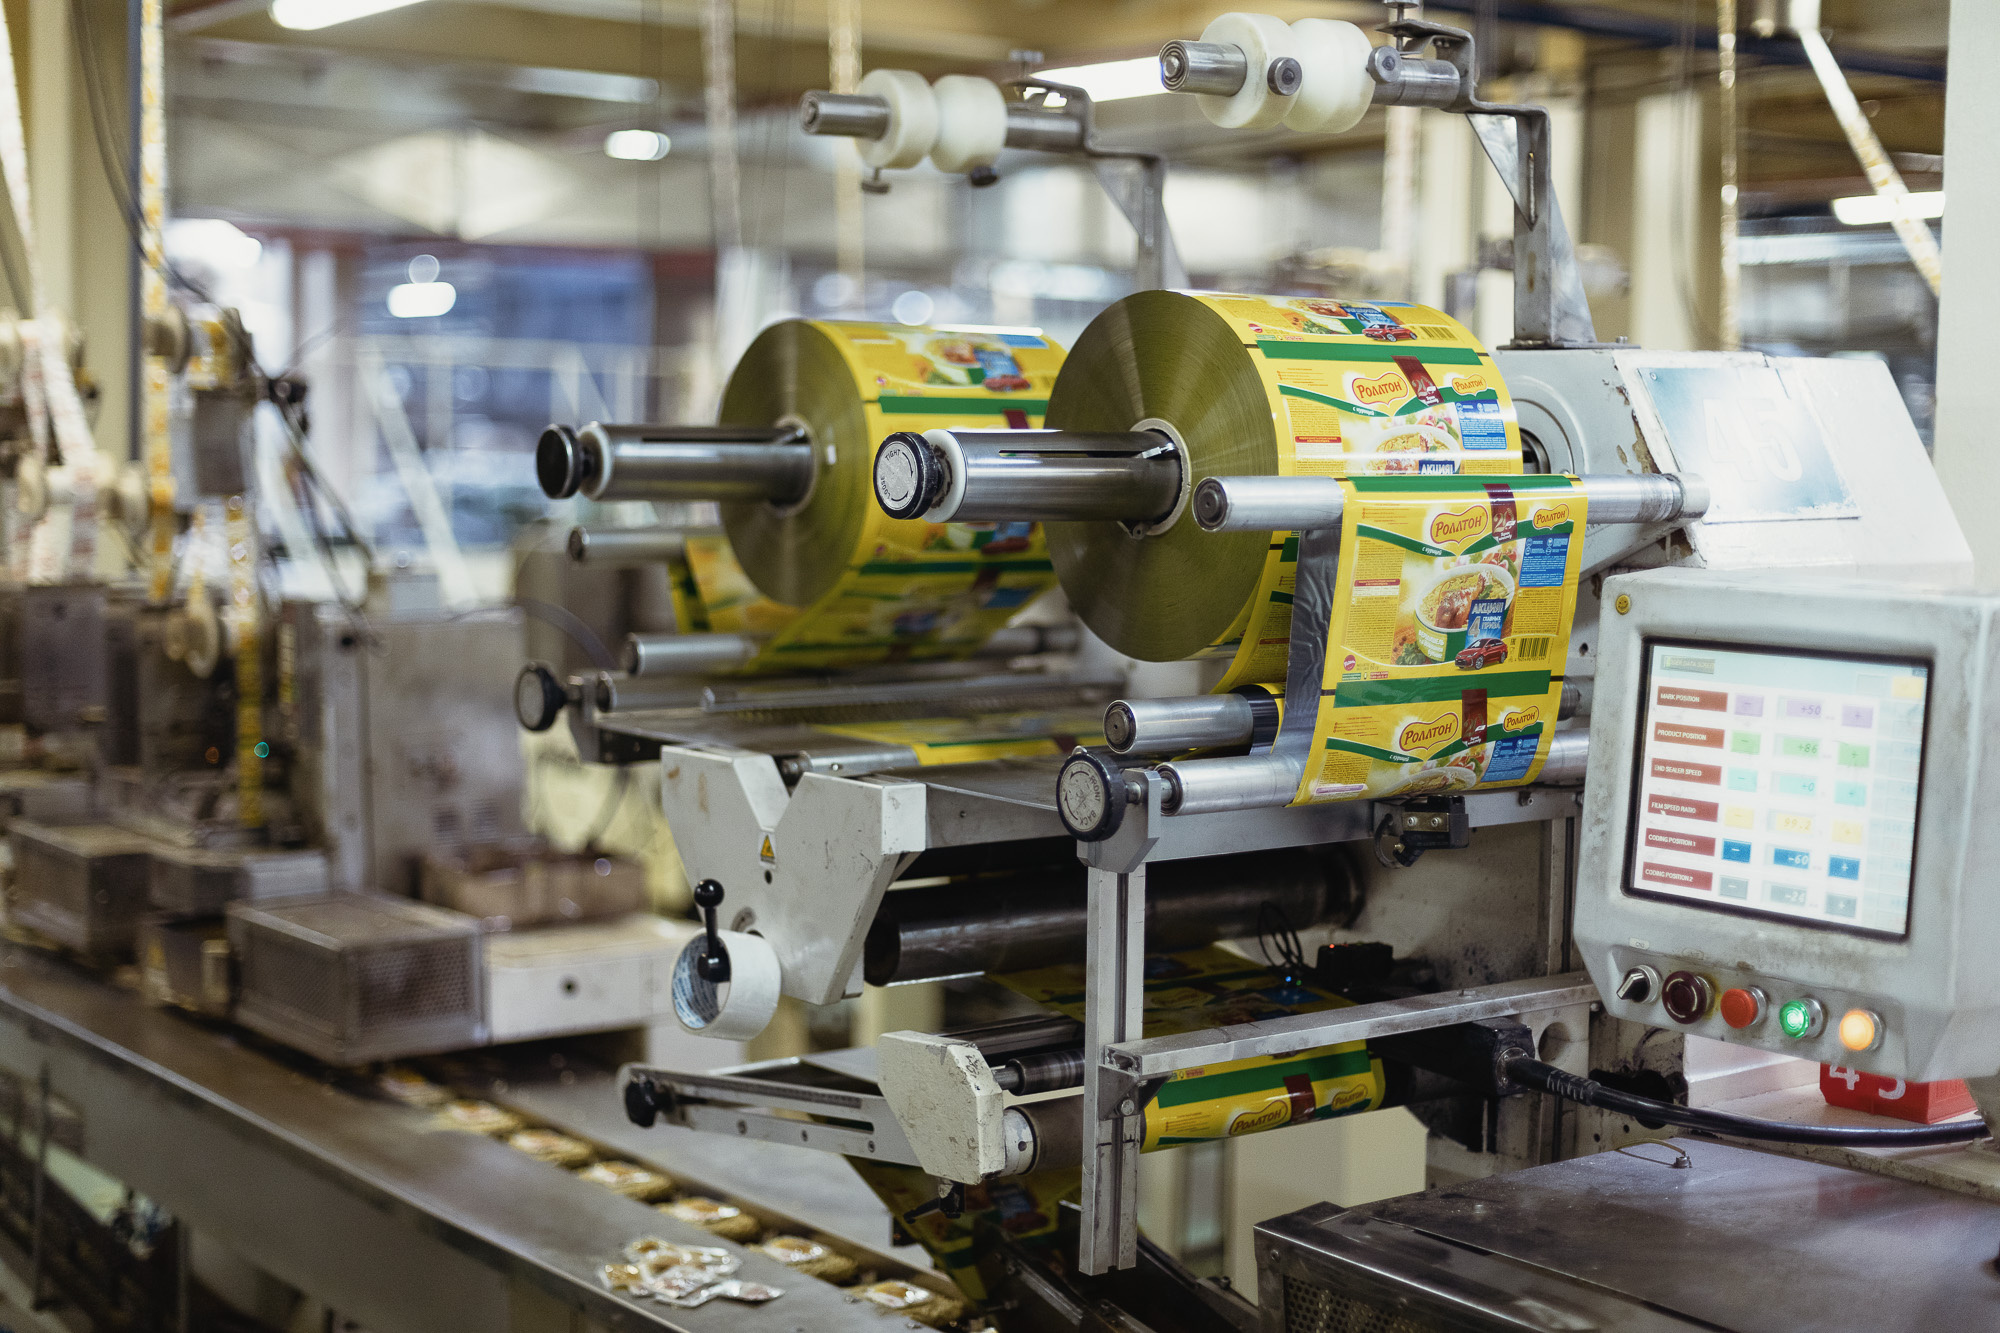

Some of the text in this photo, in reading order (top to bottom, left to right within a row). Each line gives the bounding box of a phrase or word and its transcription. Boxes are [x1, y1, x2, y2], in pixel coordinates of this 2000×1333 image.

[1702, 397, 1803, 483] 45
[885, 449, 901, 461] TIGHT
[1468, 616, 1481, 638] 4
[1660, 693, 1700, 703] MARK POSITION
[1657, 729, 1707, 741] PRODUCT POSITION
[1666, 766, 1685, 775] SEALER
[1685, 768, 1702, 777] SPEED
[1090, 776, 1101, 802] FRONT
[1651, 801, 1697, 814] FILM SPEED RATIO
[1080, 810, 1097, 826] BACK
[1648, 834, 1668, 843] CODING
[1669, 837, 1692, 846] POSITION
[1645, 868, 1665, 878] CODING
[1665, 872, 1689, 882] POSITION
